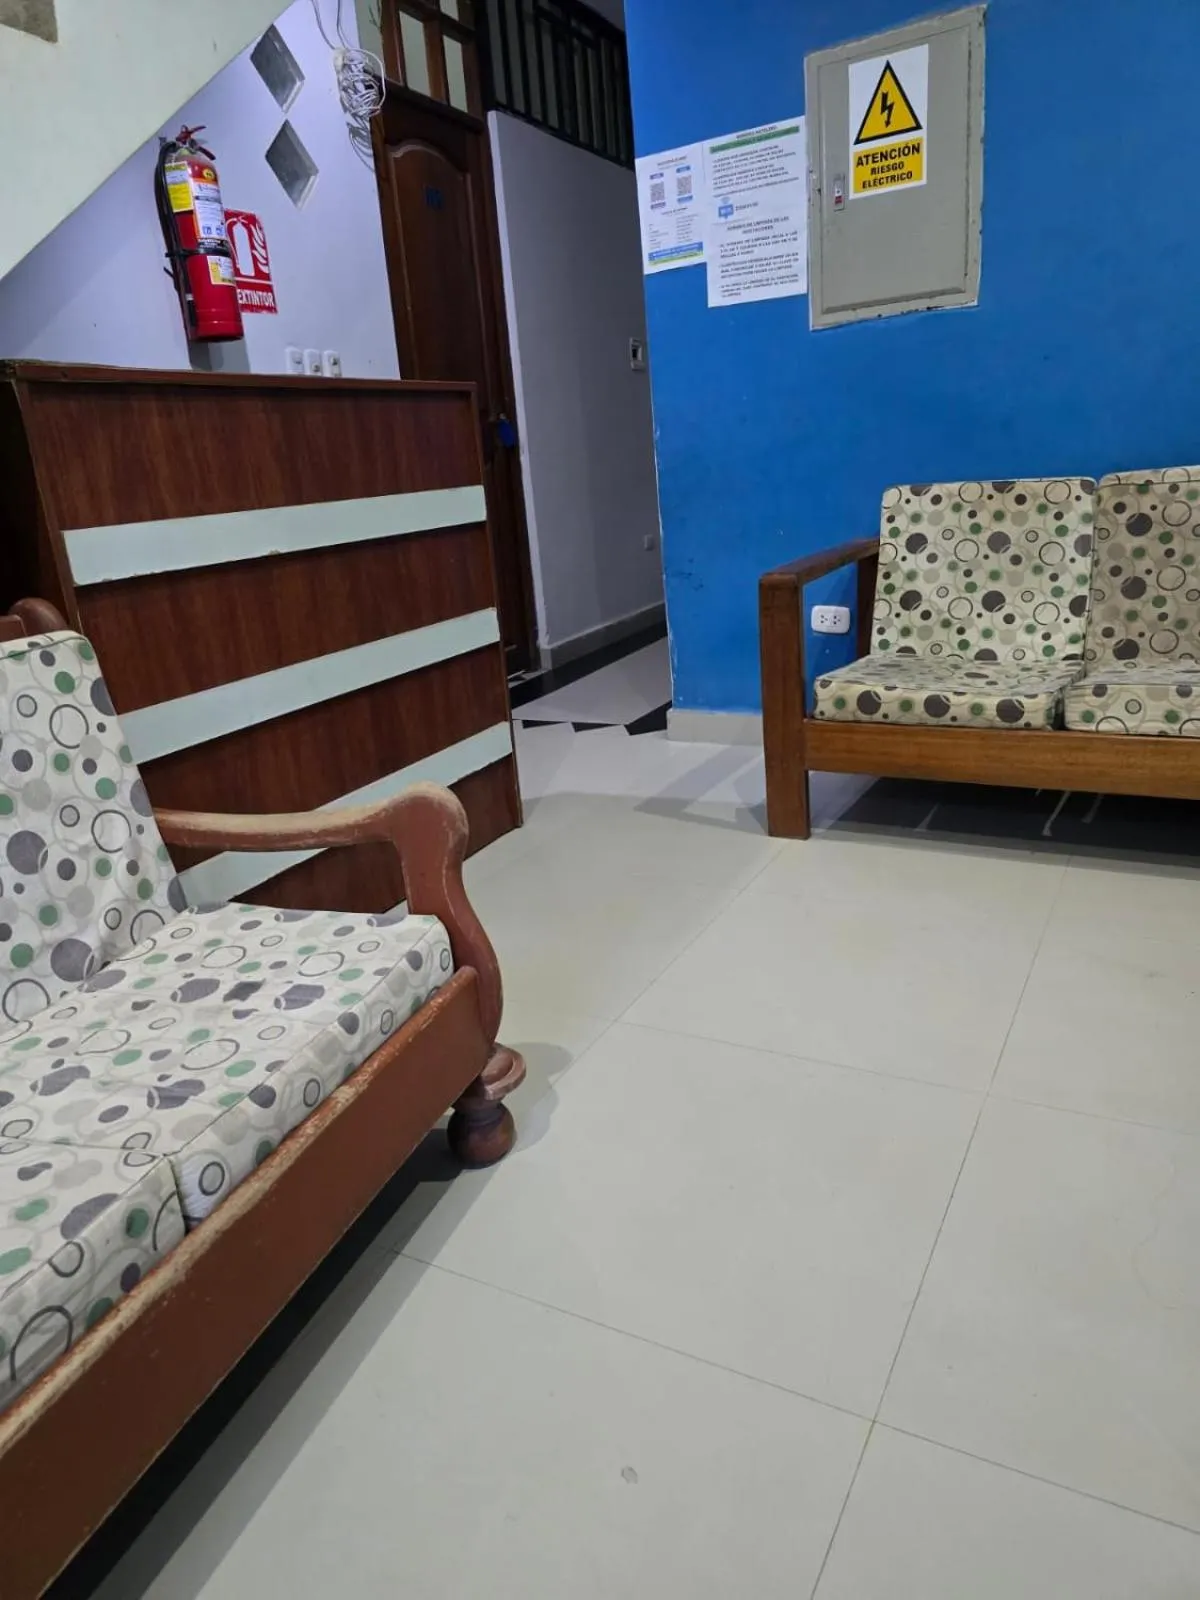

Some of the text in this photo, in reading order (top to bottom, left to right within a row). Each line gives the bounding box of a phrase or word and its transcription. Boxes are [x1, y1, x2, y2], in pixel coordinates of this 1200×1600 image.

[855, 141, 921, 168] ATENCIÓN
[870, 160, 905, 175] RIESGO
[237, 288, 275, 307] EXTINTOR
